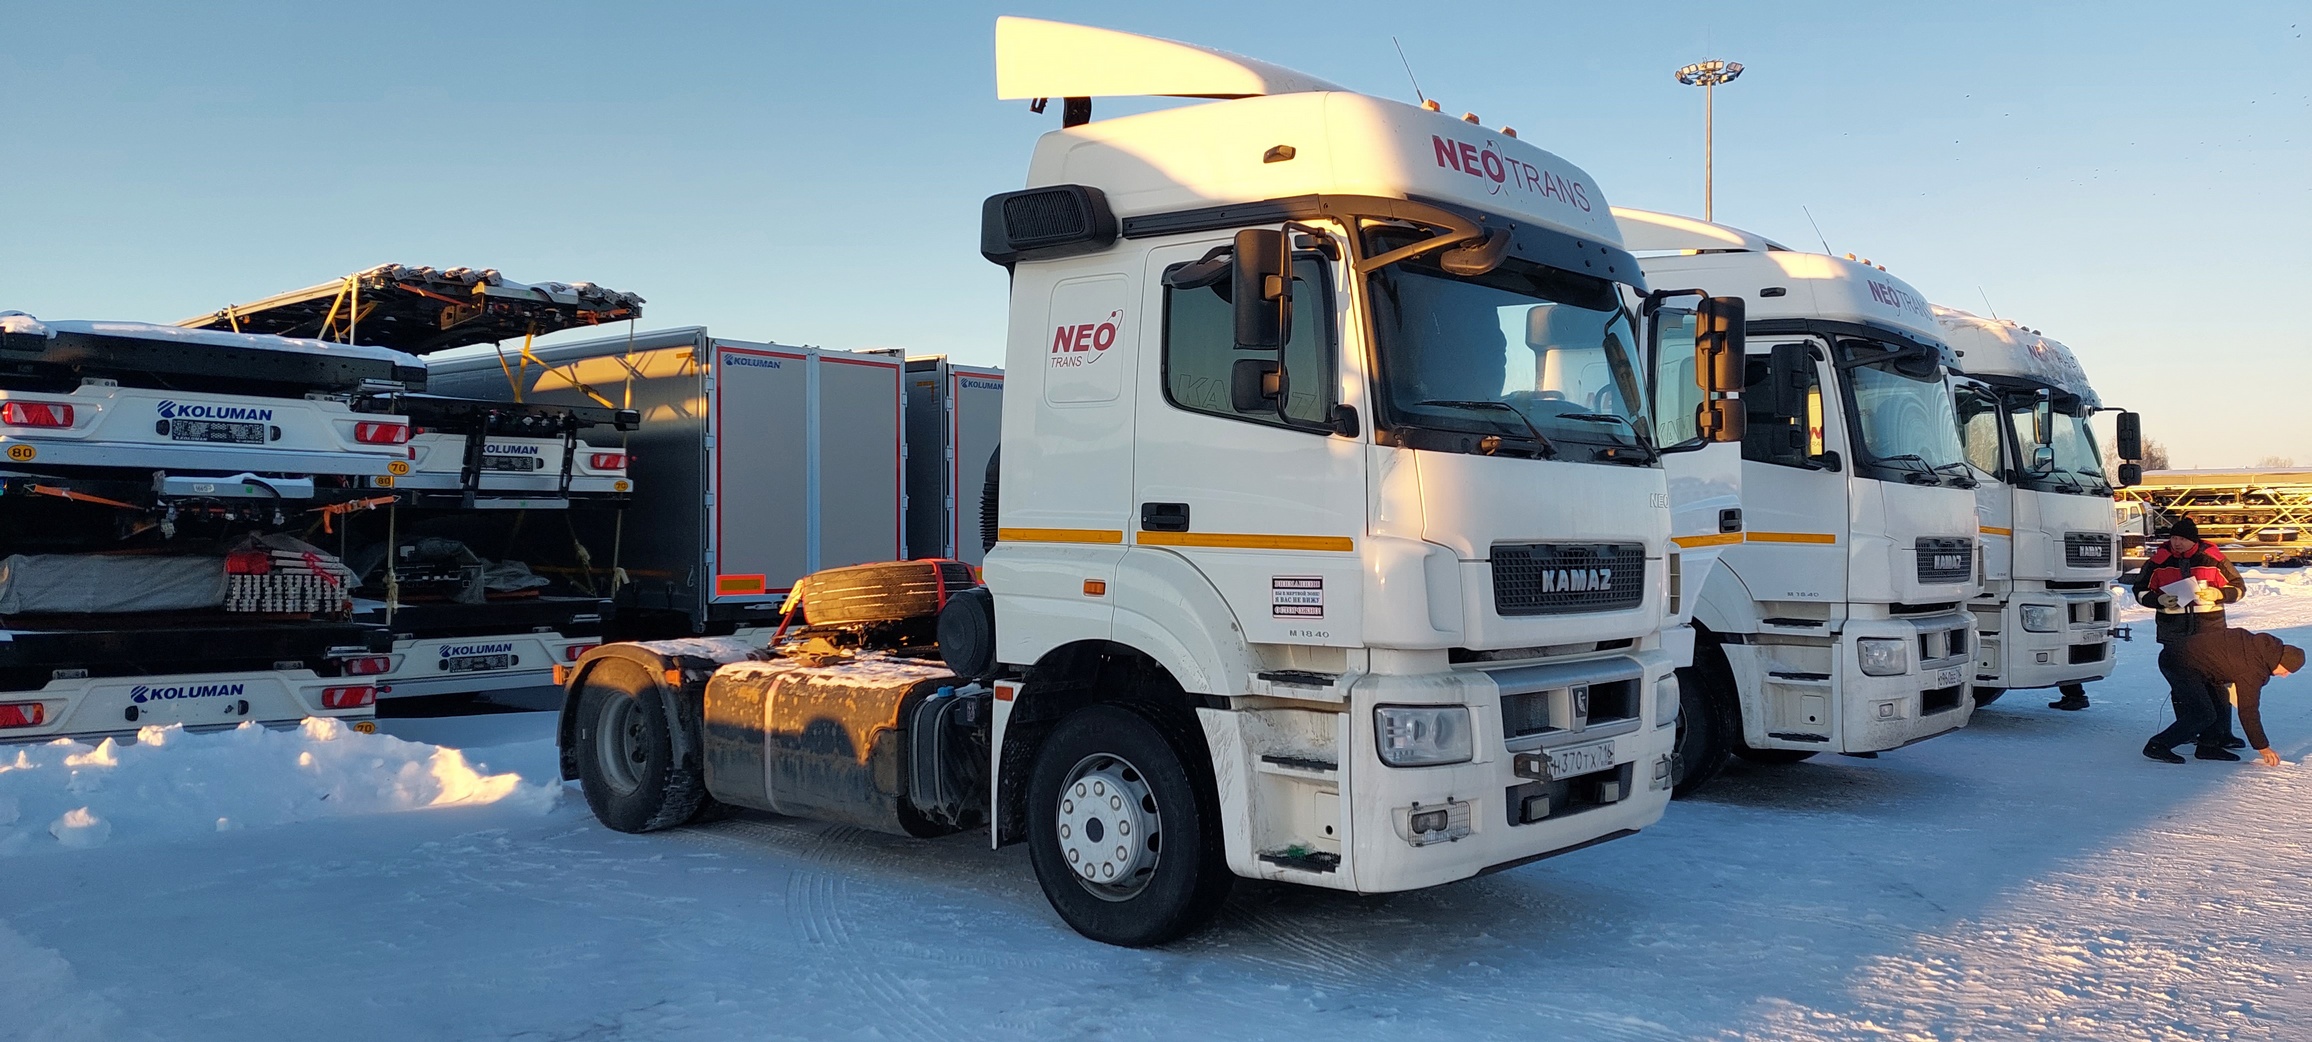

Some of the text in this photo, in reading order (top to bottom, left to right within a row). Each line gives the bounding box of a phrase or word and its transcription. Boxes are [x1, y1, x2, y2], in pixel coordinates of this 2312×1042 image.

[1052, 322, 1116, 353] NEO
[734, 356, 781, 369] KOLUMAN
[1051, 356, 1082, 368] TRANS
[968, 380, 1004, 390] KOLUMAN
[177, 403, 273, 421] KOLUMAN
[11, 448, 33, 458] 80
[391, 463, 406, 473] 70
[1934, 555, 1962, 569] KAMAZ
[1542, 568, 1612, 593] KAMAZ
[451, 643, 512, 656] KOLUMAN
[150, 684, 244, 701] KOLUMAN
